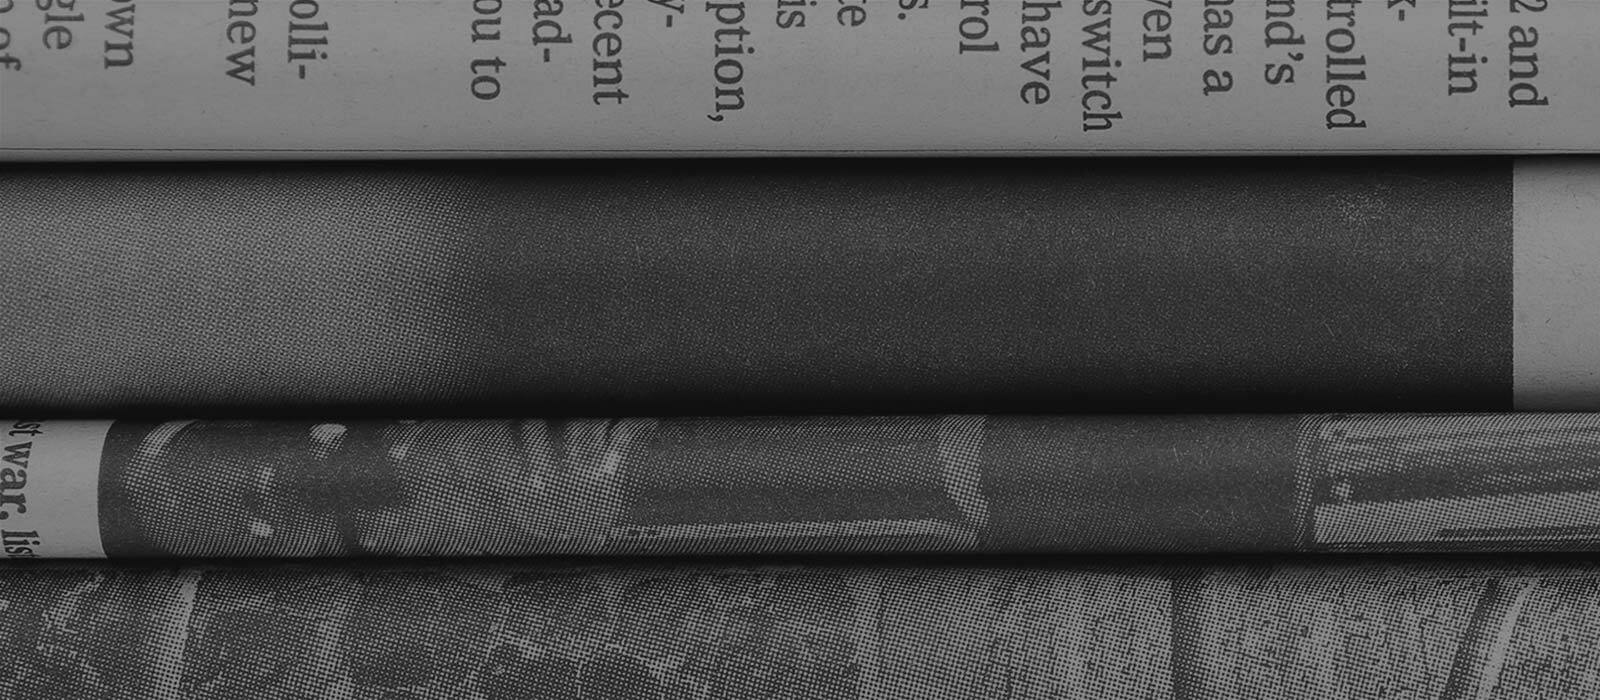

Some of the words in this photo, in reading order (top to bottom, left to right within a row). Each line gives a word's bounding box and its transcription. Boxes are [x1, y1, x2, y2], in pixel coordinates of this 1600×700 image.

[103, 0, 136, 70] wn
[225, 0, 259, 87] new
[287, 0, 329, 80] olli-
[531, 0, 573, 63] ad-
[704, 1, 755, 123] ption,
[958, 0, 1000, 55] rol
[1019, 0, 1063, 105] have
[1202, 0, 1235, 56] as
[1325, 0, 1368, 130] trolled
[470, 56, 507, 101] to
[1080, 0, 1124, 133] switch
[1202, 69, 1234, 97] a
[1508, 25, 1550, 109] and
[1, 529, 41, 558] lis
